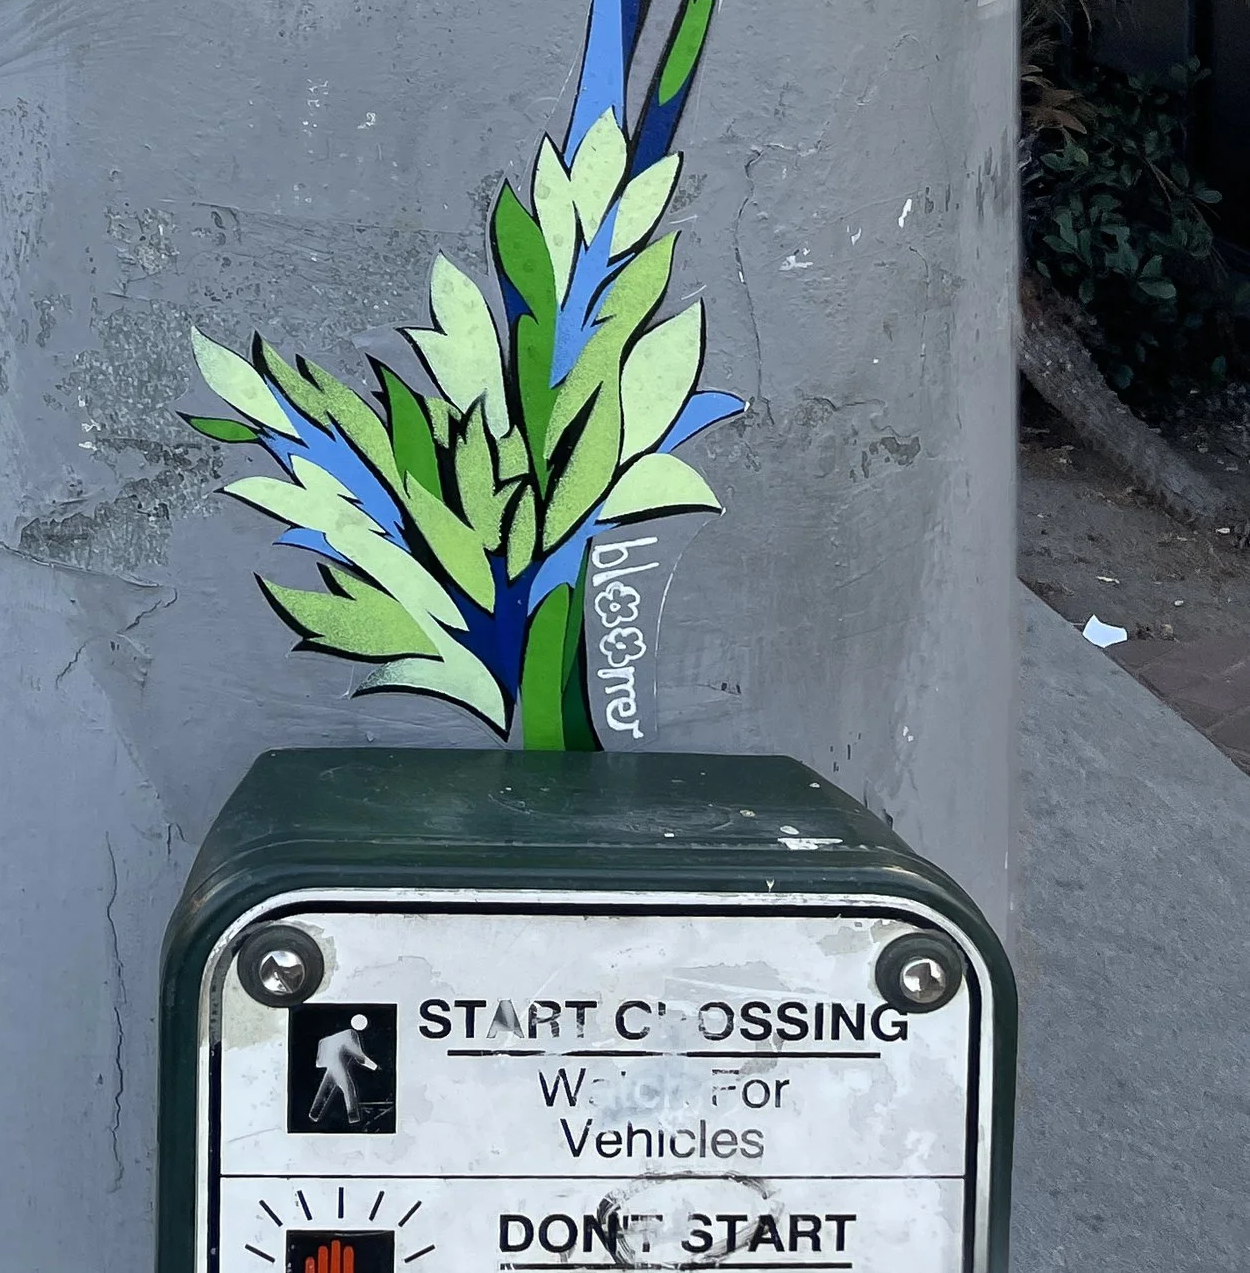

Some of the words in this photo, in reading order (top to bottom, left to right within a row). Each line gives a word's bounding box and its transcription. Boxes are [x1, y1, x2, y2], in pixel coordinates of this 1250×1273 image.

[419, 998, 598, 1041] START
[615, 1000, 909, 1042] COSSING
[559, 1117, 765, 1159] Vehicles
[681, 1213, 856, 1253] START
